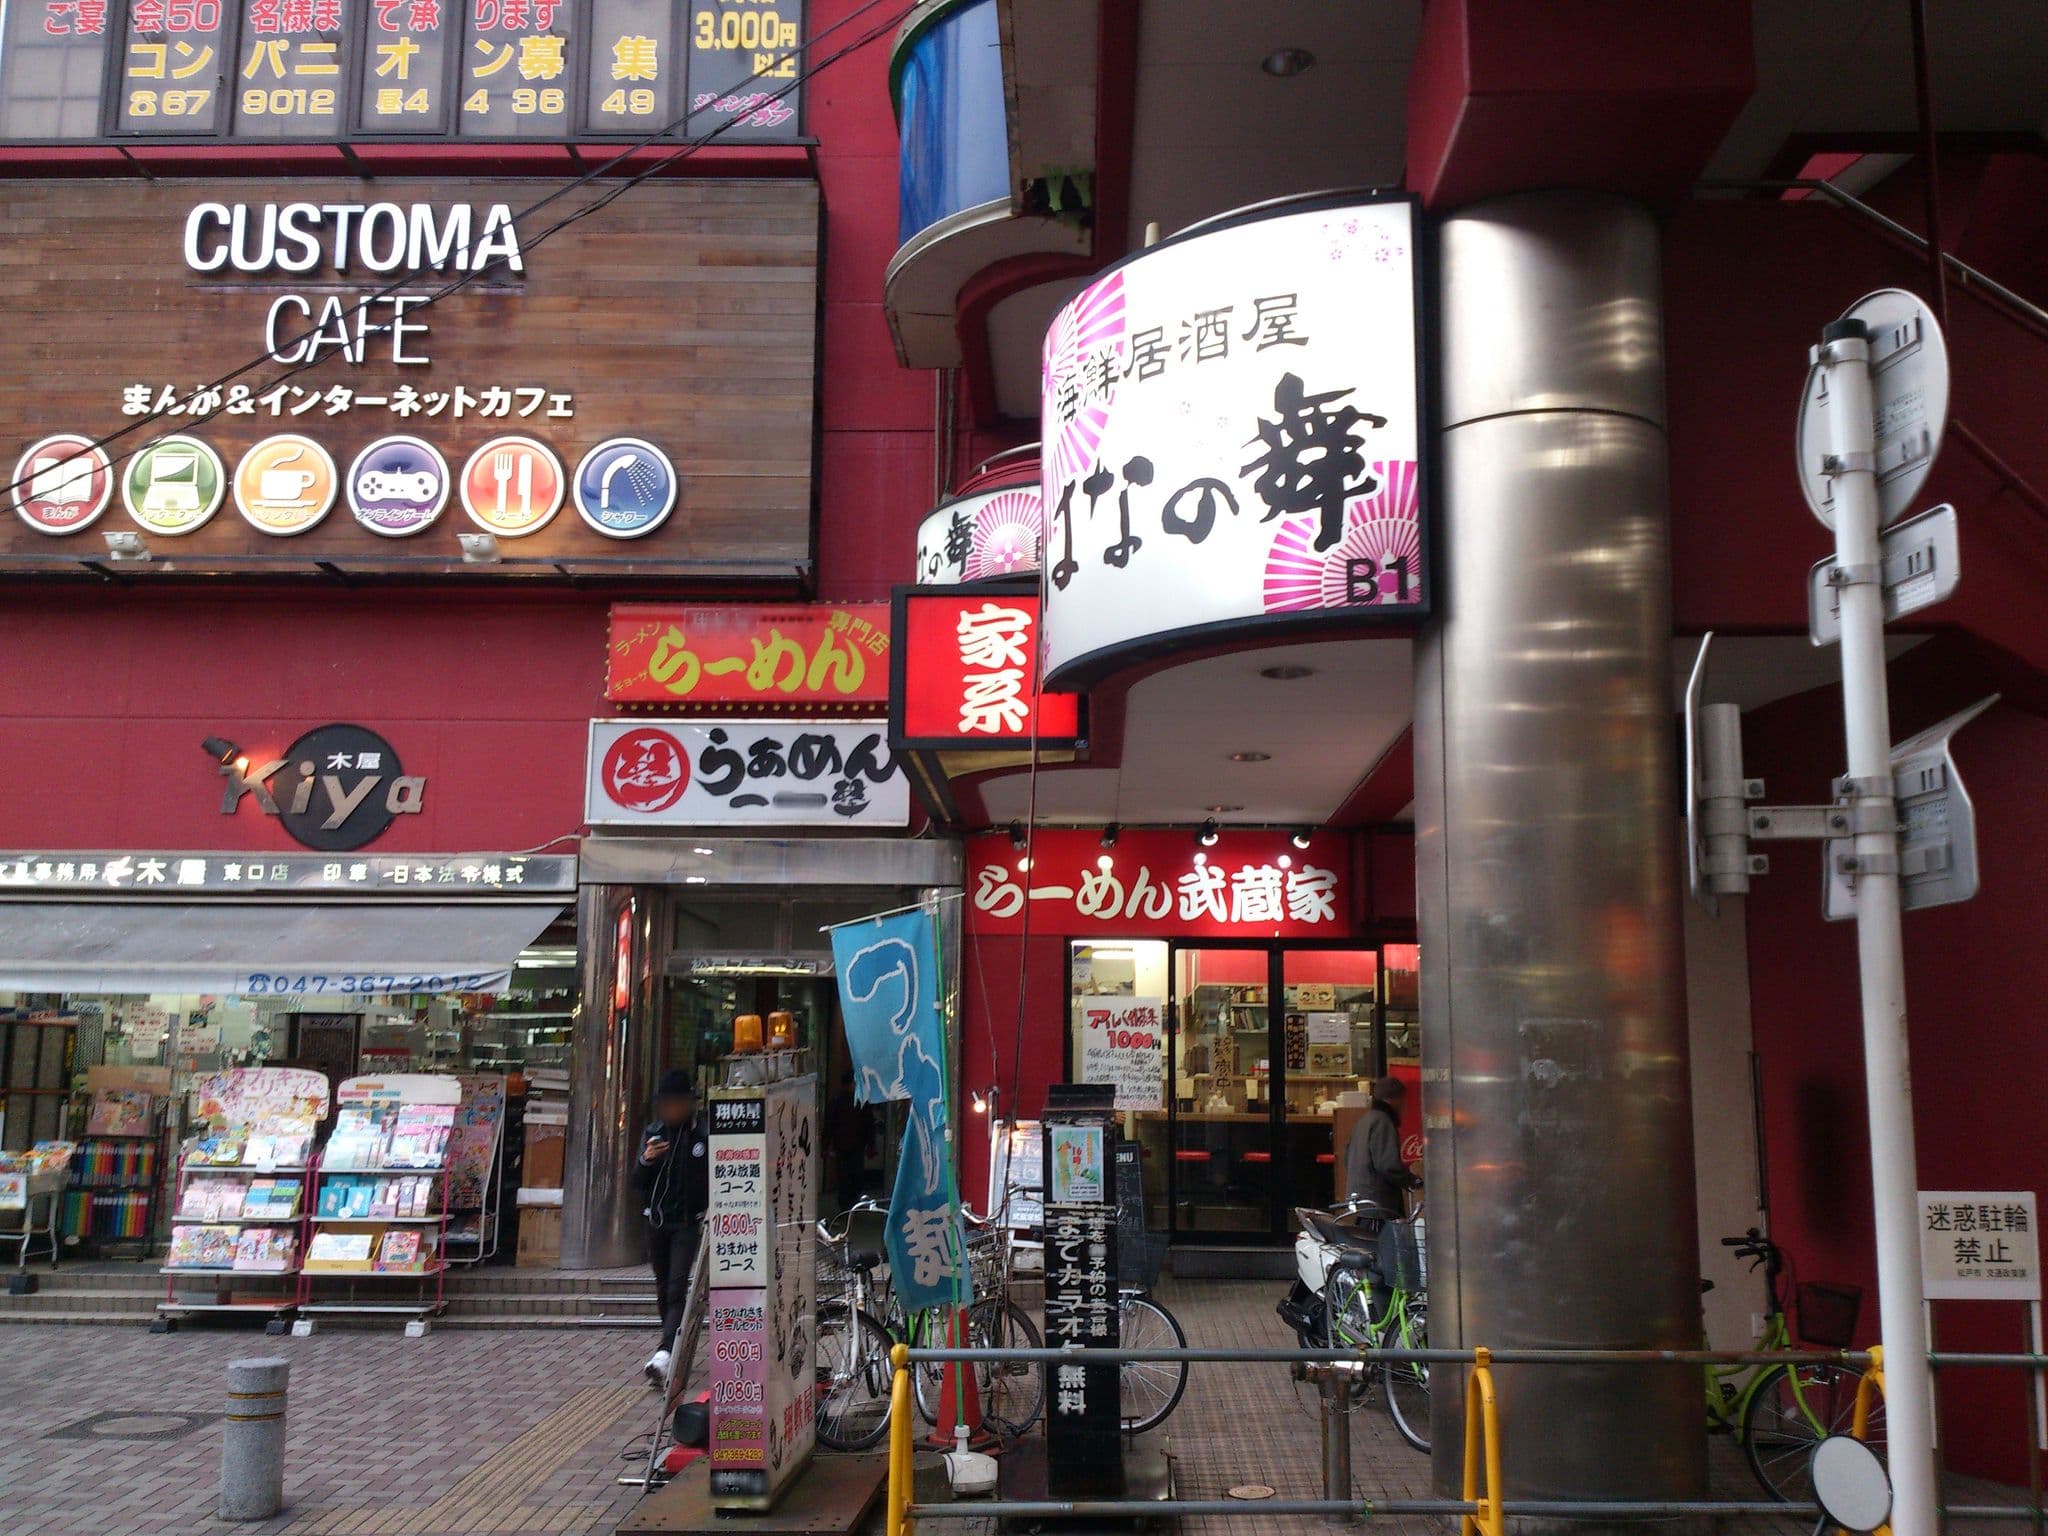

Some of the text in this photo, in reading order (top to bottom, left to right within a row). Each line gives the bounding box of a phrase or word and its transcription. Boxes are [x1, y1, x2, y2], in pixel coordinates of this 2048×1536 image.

[694, 11, 797, 49] 3,000円
[127, 35, 658, 81] コン パニ オ ン募 集
[753, 52, 797, 78] 以上
[242, 89, 336, 115] 9012
[601, 89, 655, 114] 49
[184, 203, 525, 273] CUSTOMA
[265, 295, 431, 365] CAFE
[1056, 293, 1308, 423] 海鮮居酒屋
[121, 385, 574, 419] まんが&インターネットカフェ
[601, 510, 648, 523] シャワー
[1346, 557, 1412, 602] B1
[615, 622, 661, 656] ラーメン
[829, 610, 891, 656] 専門店
[648, 624, 865, 695] らーめん
[956, 602, 1033, 735] 家系
[327, 752, 381, 770] 木屋
[695, 727, 899, 796] らあめん
[219, 758, 427, 830] Kiya
[136, 858, 207, 885] 木屋
[223, 863, 288, 882] 東口店
[323, 863, 368, 882] 印章
[974, 864, 1339, 924] らーめん武蔵家
[714, 1163, 761, 1179] 飲み放題
[719, 1180, 756, 1194] コース
[1926, 1203, 2029, 1233] 迷惑駐輪
[715, 1241, 759, 1256] おまかせ
[719, 1257, 756, 1272] コース
[1953, 1237, 2014, 1265] 禁止
[714, 1319, 763, 1332] ビールセット
[716, 1339, 762, 1361] 600円
[714, 1380, 764, 1403] 1,080円
